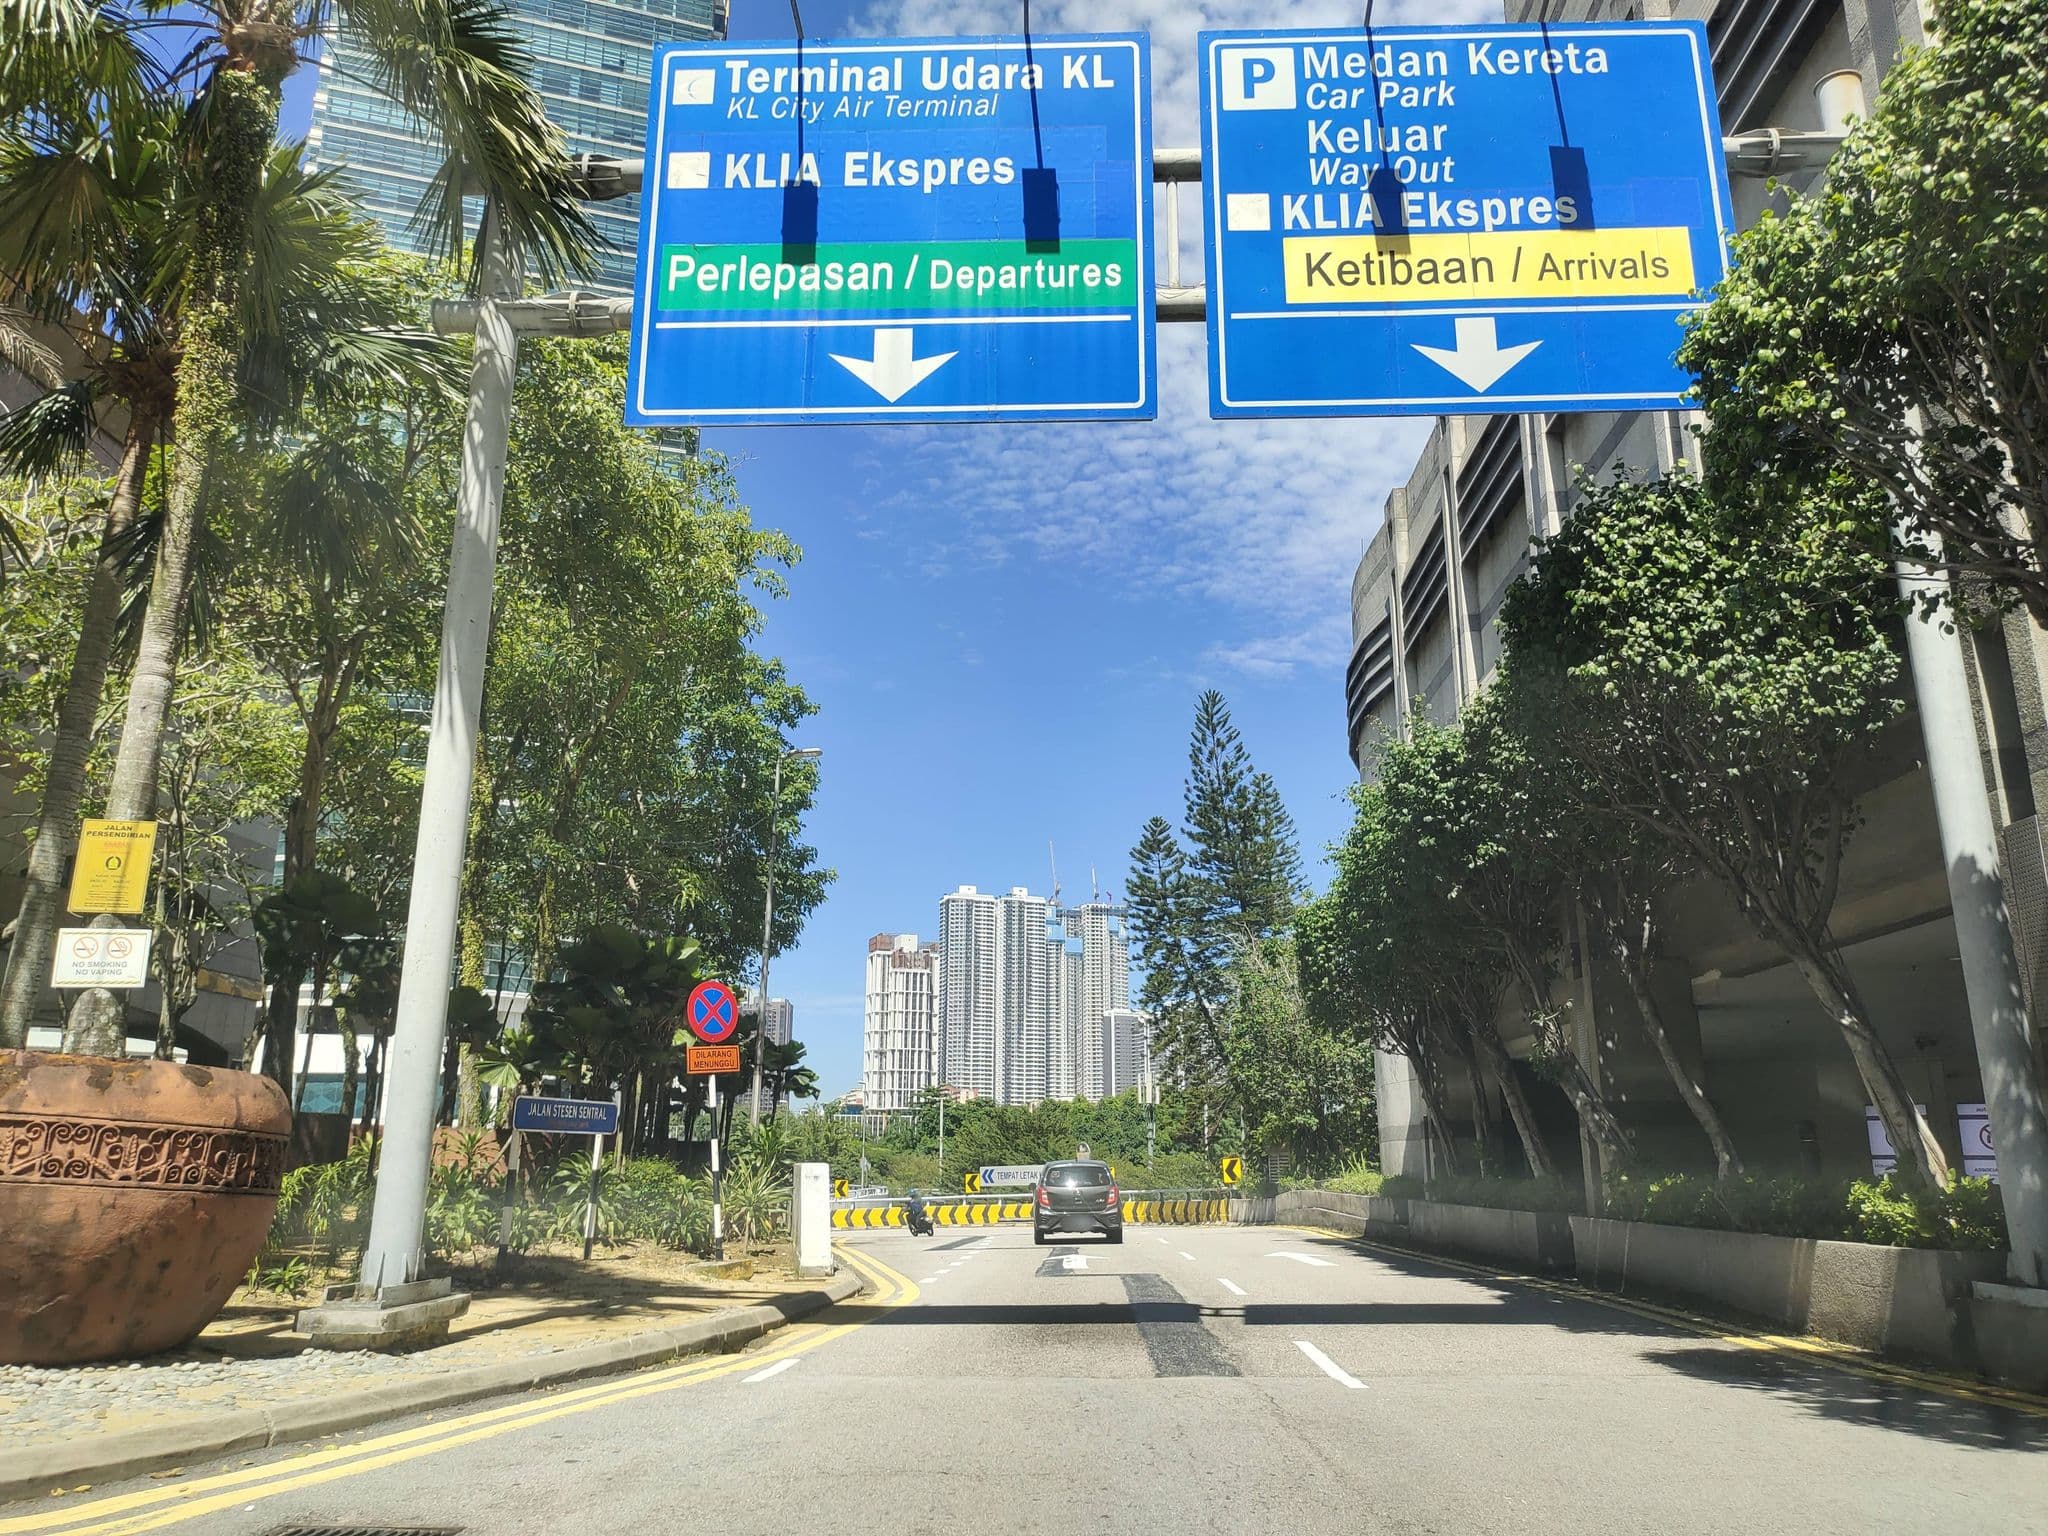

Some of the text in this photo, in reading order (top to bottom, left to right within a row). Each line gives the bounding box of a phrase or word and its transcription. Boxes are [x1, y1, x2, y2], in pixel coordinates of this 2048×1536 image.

[725, 55, 1115, 94] Terminal Udara KL
[1242, 57, 1276, 99] P
[1303, 42, 1609, 80] Medan Kereta
[727, 93, 1000, 124] KL City Air Terminal
[1306, 80, 1456, 109] Car Park
[1308, 117, 1448, 154] Keluar
[725, 151, 1015, 194] KLIA Ekspres
[1309, 156, 1455, 188] Way Out
[1283, 192, 1578, 232] KLIA Ekspres
[668, 254, 1122, 299] Perlepasan / Departures
[1305, 246, 1670, 287] Ketibaan / Arrivals
[86, 831, 151, 839] PERSENDIRIAN
[694, 1059, 735, 1069] MENUNGGU
[695, 1050, 732, 1059] DILARANG
[528, 1103, 607, 1120] JALAN STESEN SENTRAL
[997, 1171, 1039, 1180] TEMPAT LETAK
